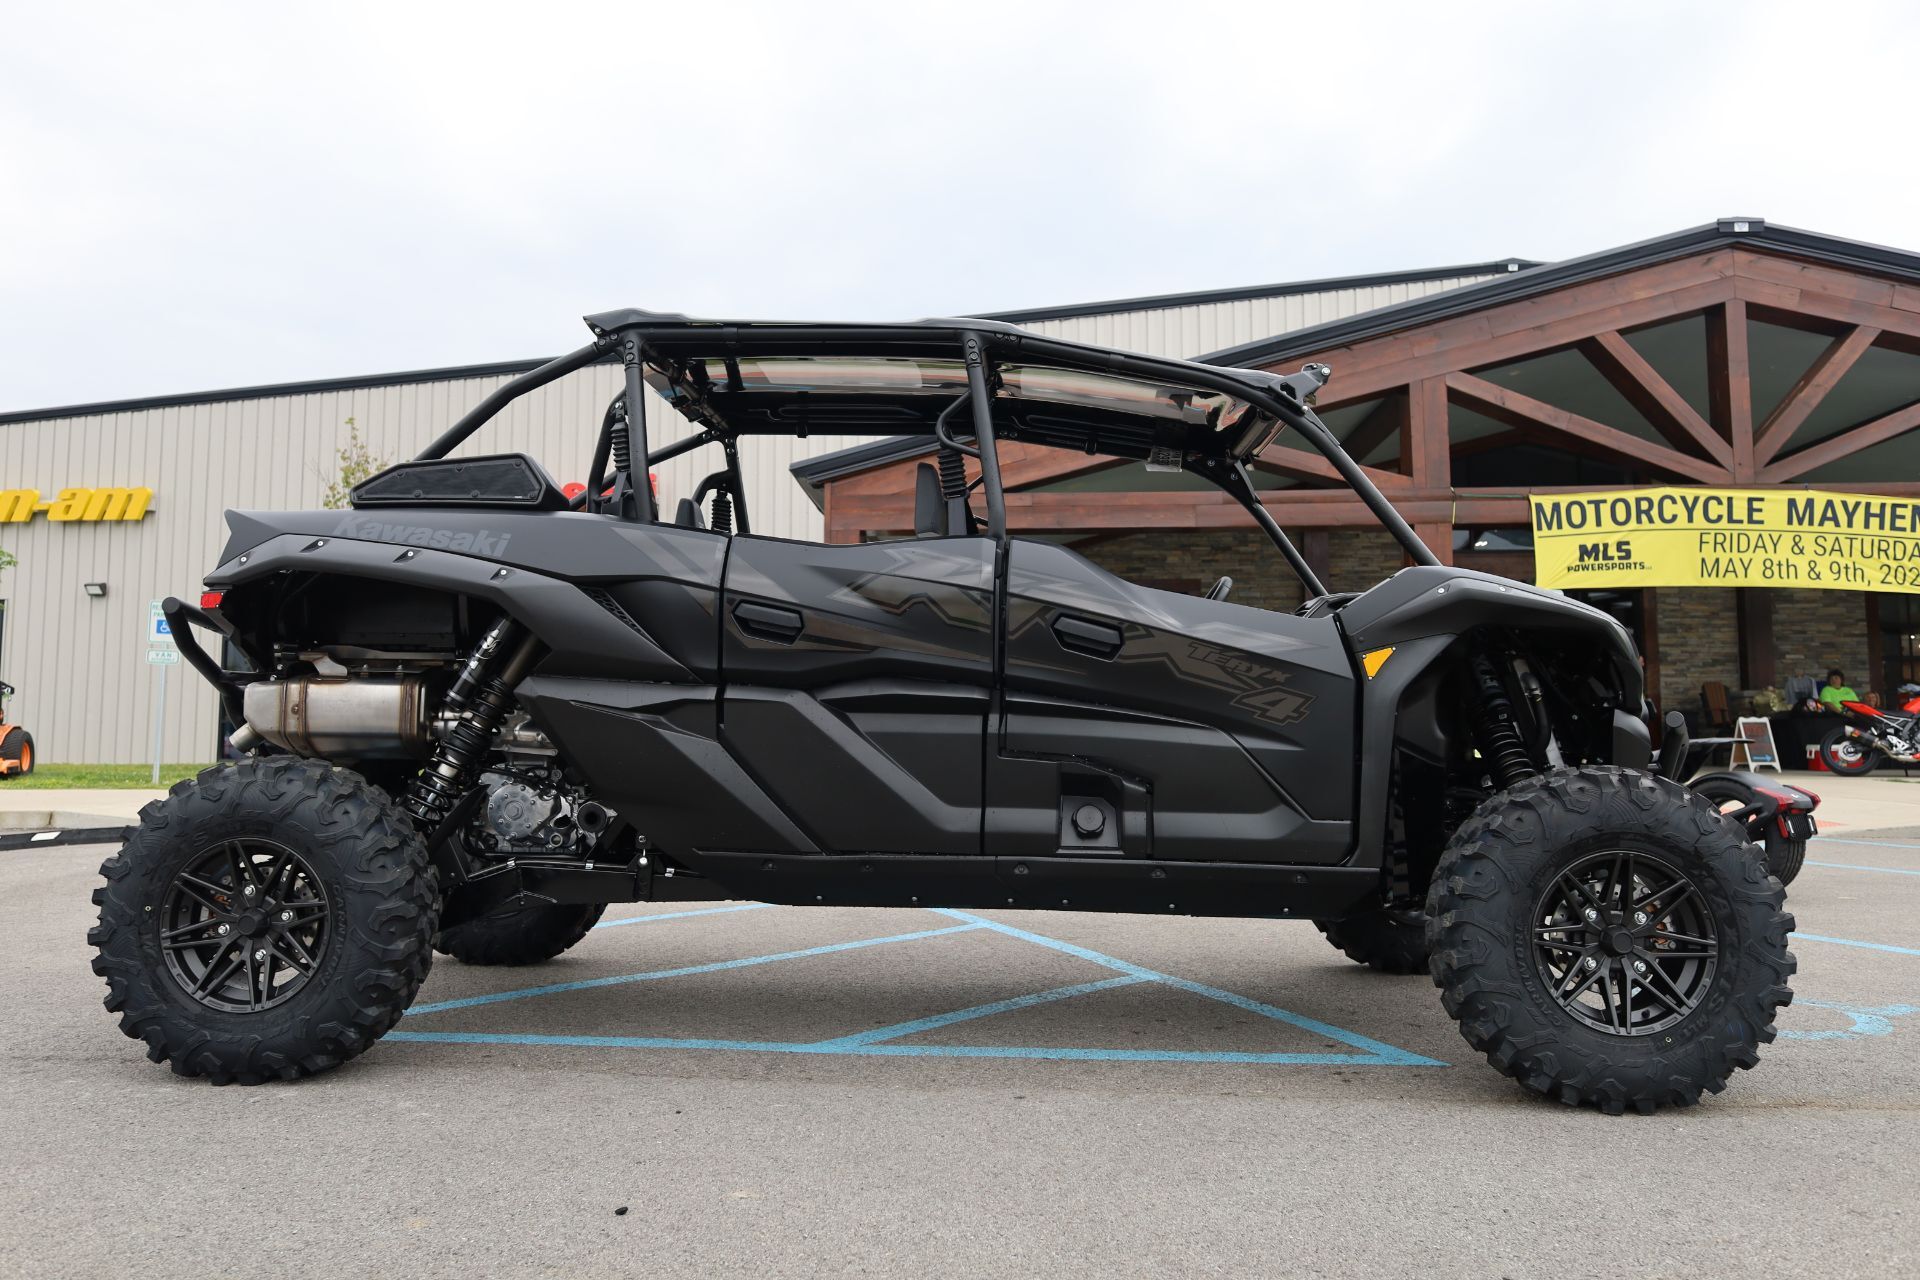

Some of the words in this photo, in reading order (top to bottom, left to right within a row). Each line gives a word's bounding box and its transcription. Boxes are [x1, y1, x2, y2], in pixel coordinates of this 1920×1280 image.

[1535, 495, 1765, 531] MOTORCYCLE
[333, 515, 512, 558] Kawasaki
[1578, 541, 1631, 562] MLS
[1699, 532, 1782, 554] FRIDAY
[1791, 534, 1805, 555] &
[1567, 562, 1645, 573] POWERSPORTS
[1701, 557, 1752, 578] MAY
[1762, 558, 1798, 579] 8th
[1807, 560, 1822, 580] &
[1829, 561, 1871, 587] 9th,
[1186, 640, 1293, 682] TERYX
[1236, 688, 1312, 724] 4
